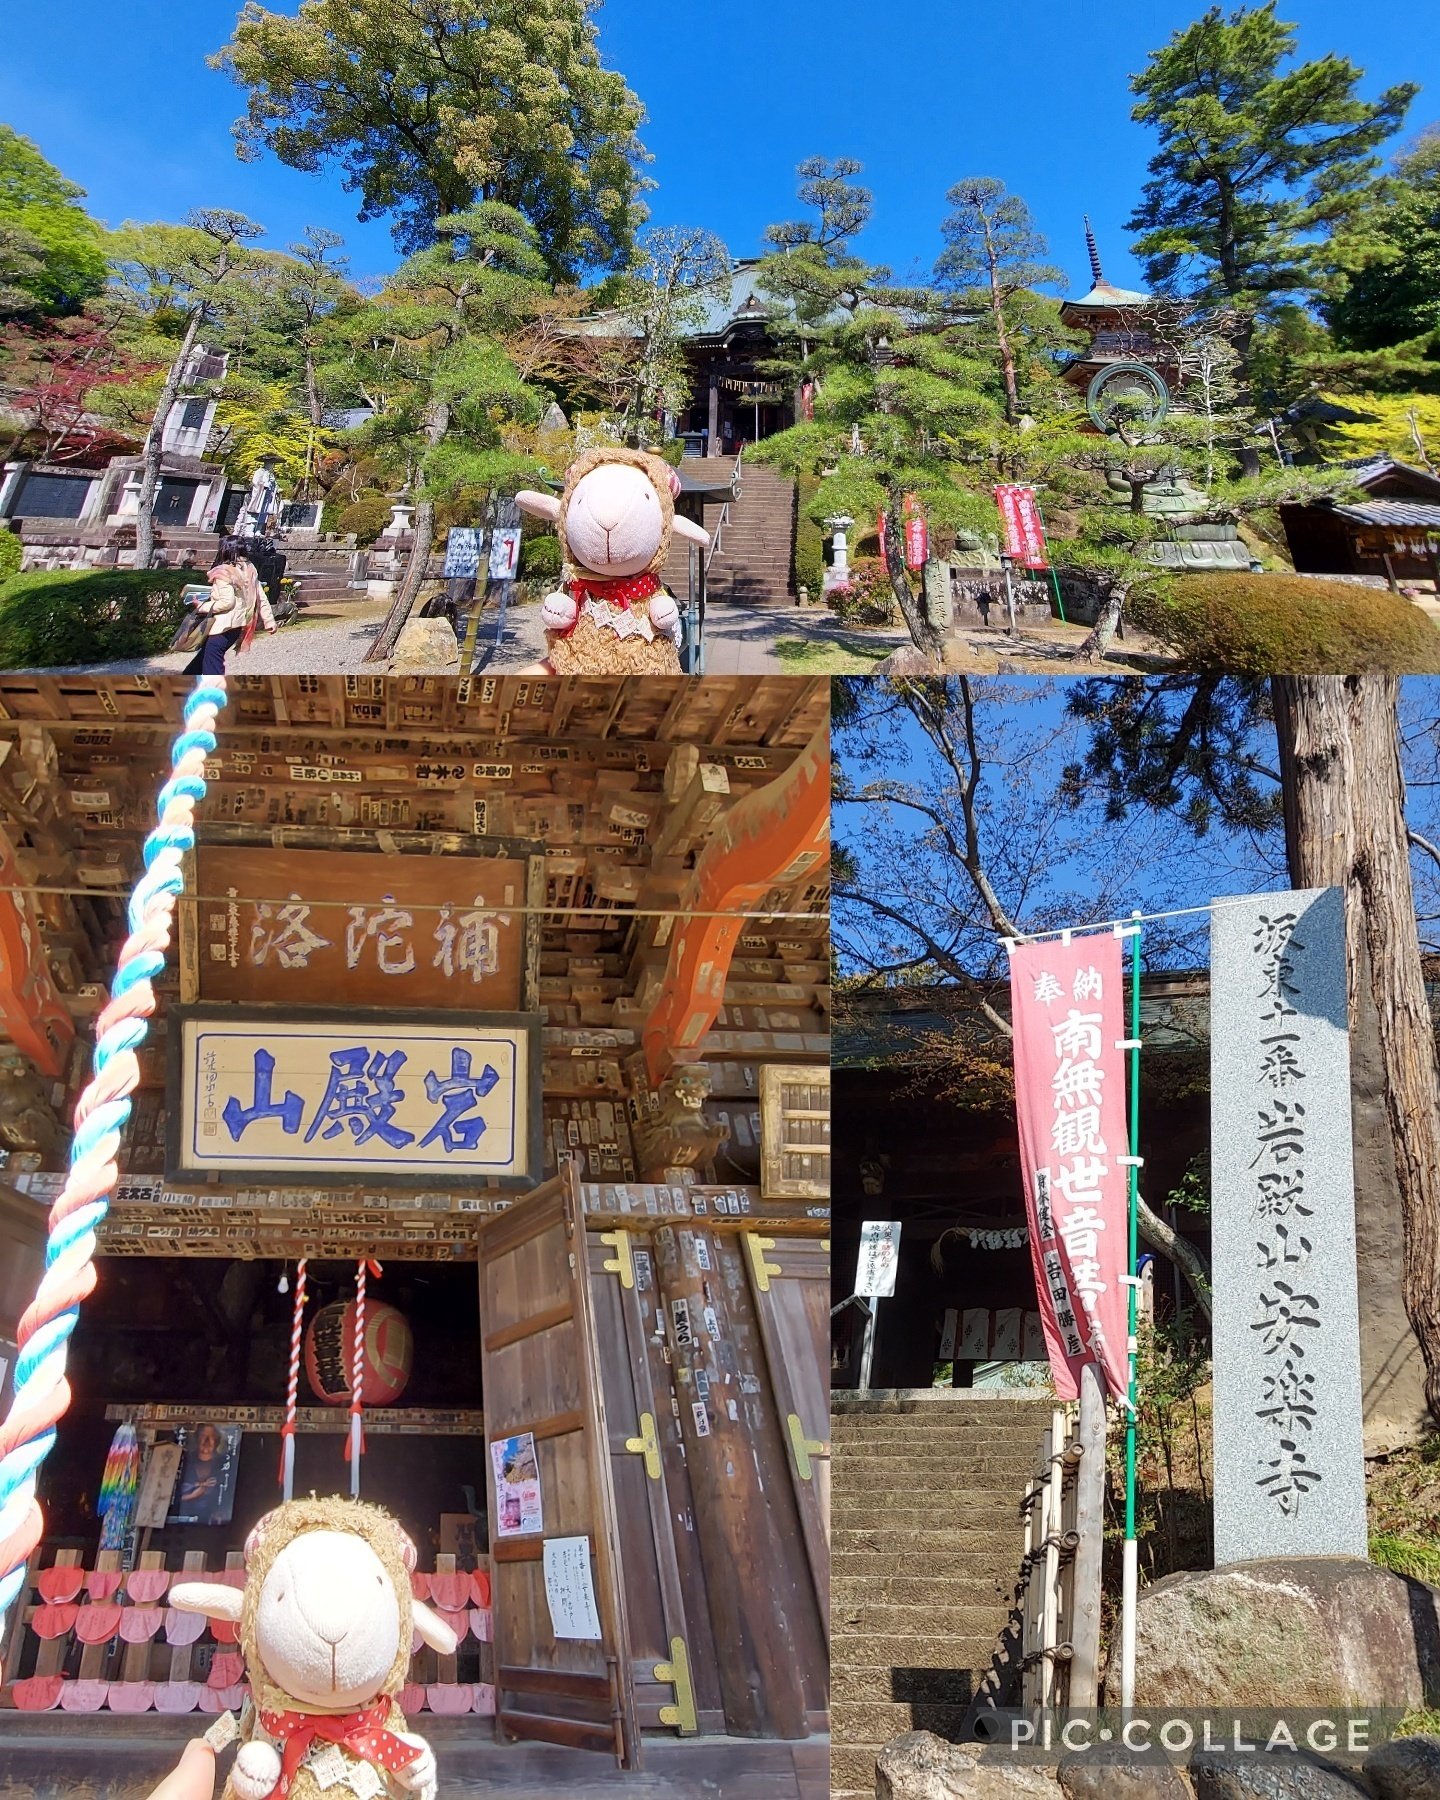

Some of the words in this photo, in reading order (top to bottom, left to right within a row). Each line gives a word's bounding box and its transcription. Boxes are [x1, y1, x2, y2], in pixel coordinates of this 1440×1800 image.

[1034, 966, 1103, 1006] 奉納
[1047, 1259, 1082, 1355] 吉田勝彦
